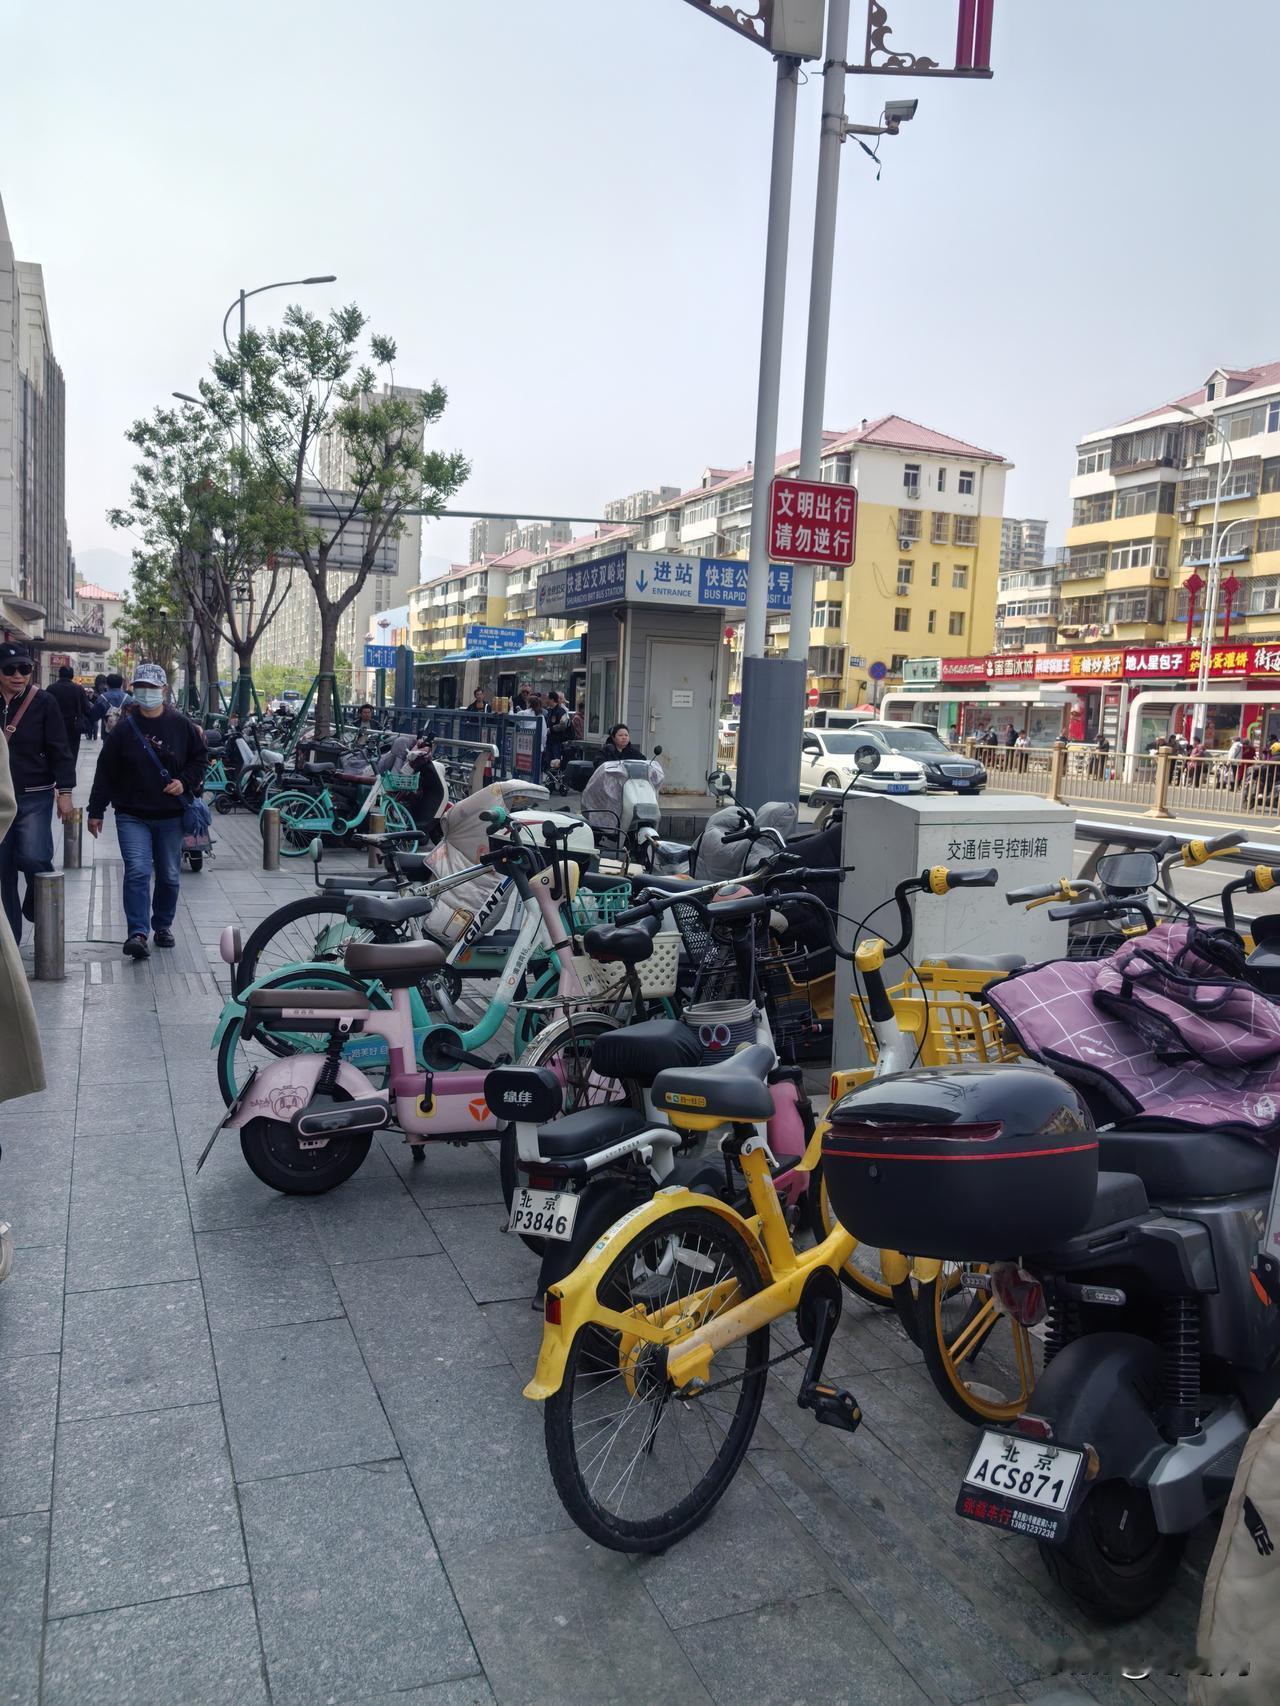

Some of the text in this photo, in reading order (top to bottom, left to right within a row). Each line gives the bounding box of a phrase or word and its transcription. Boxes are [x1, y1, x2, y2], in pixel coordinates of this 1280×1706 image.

[776, 488, 852, 523] 文明出行
[775, 522, 851, 557] 请勿逆行
[567, 560, 625, 593] 快速公交双峪站
[653, 561, 693, 585] 进站
[596, 591, 604, 600] BUS
[604, 586, 624, 598] STATION
[652, 587, 692, 598] ENTRANCE
[704, 589, 721, 600] BUS
[722, 590, 746, 602] RAPID
[994, 659, 1033, 676] 蜜雪冰城
[947, 836, 1049, 861] 交通信号控制箱
[463, 881, 506, 945] GIANT
[519, 1194, 558, 1211] 北京
[1001, 1445, 1059, 1471] 北京
[973, 1458, 1065, 1503] ACS871
[1010, 1519, 1056, 1539] 13661237238
